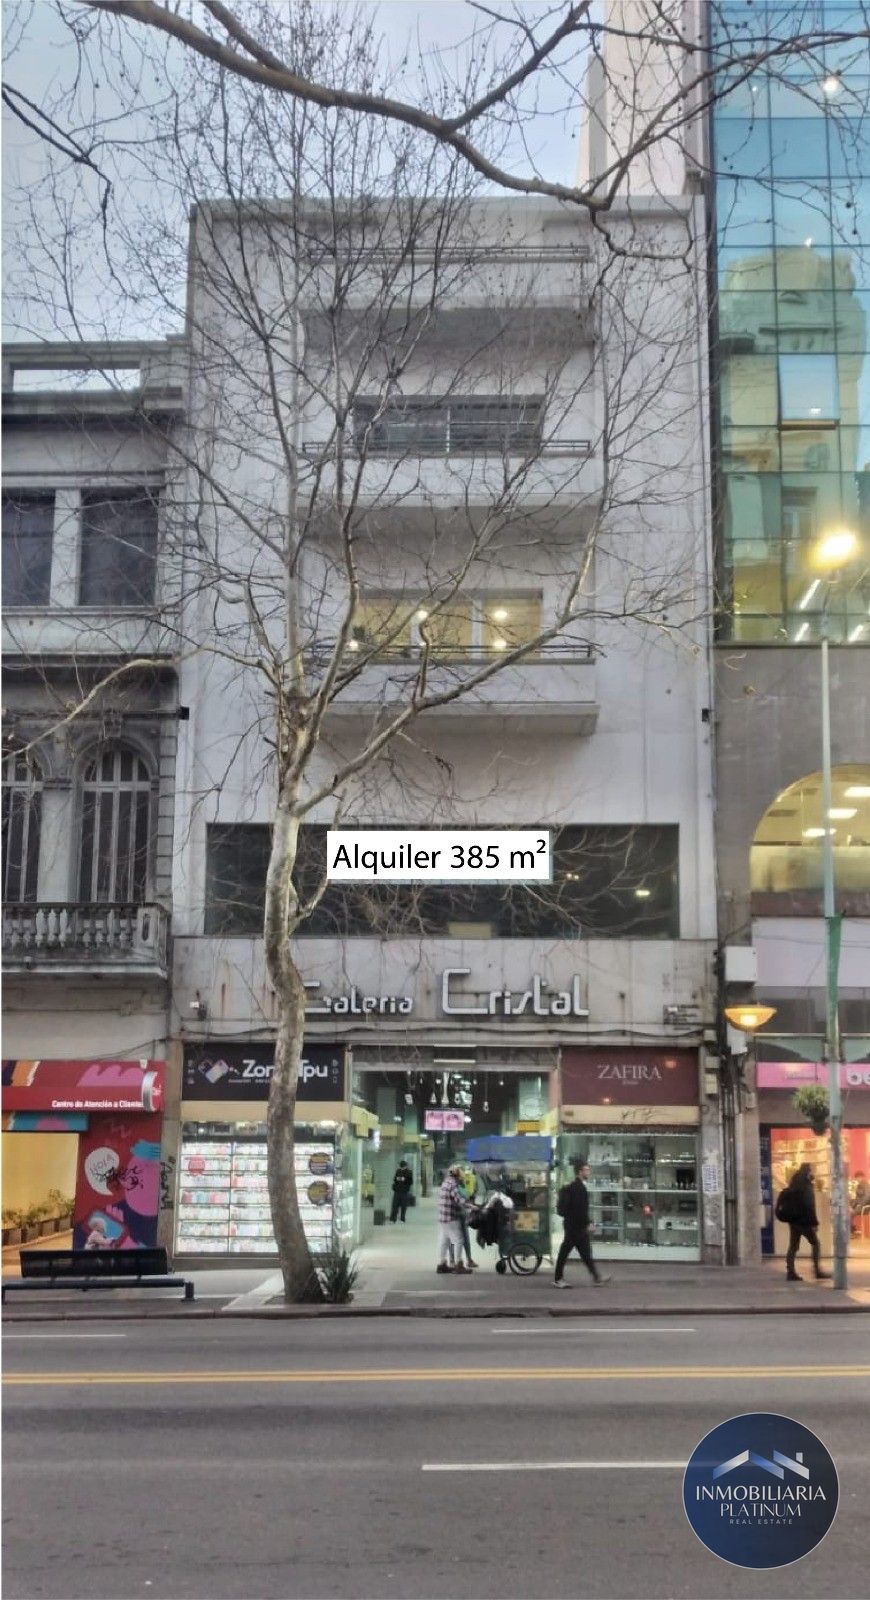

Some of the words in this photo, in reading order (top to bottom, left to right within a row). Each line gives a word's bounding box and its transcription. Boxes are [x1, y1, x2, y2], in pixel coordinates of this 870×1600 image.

[442, 968, 590, 1015] Cristal
[242, 1059, 277, 1078] Zon
[597, 1064, 662, 1080] ZAFIRA
[52, 1100, 74, 1108] Centro
[75, 1100, 83, 1108] de
[84, 1099, 113, 1108] Atención
